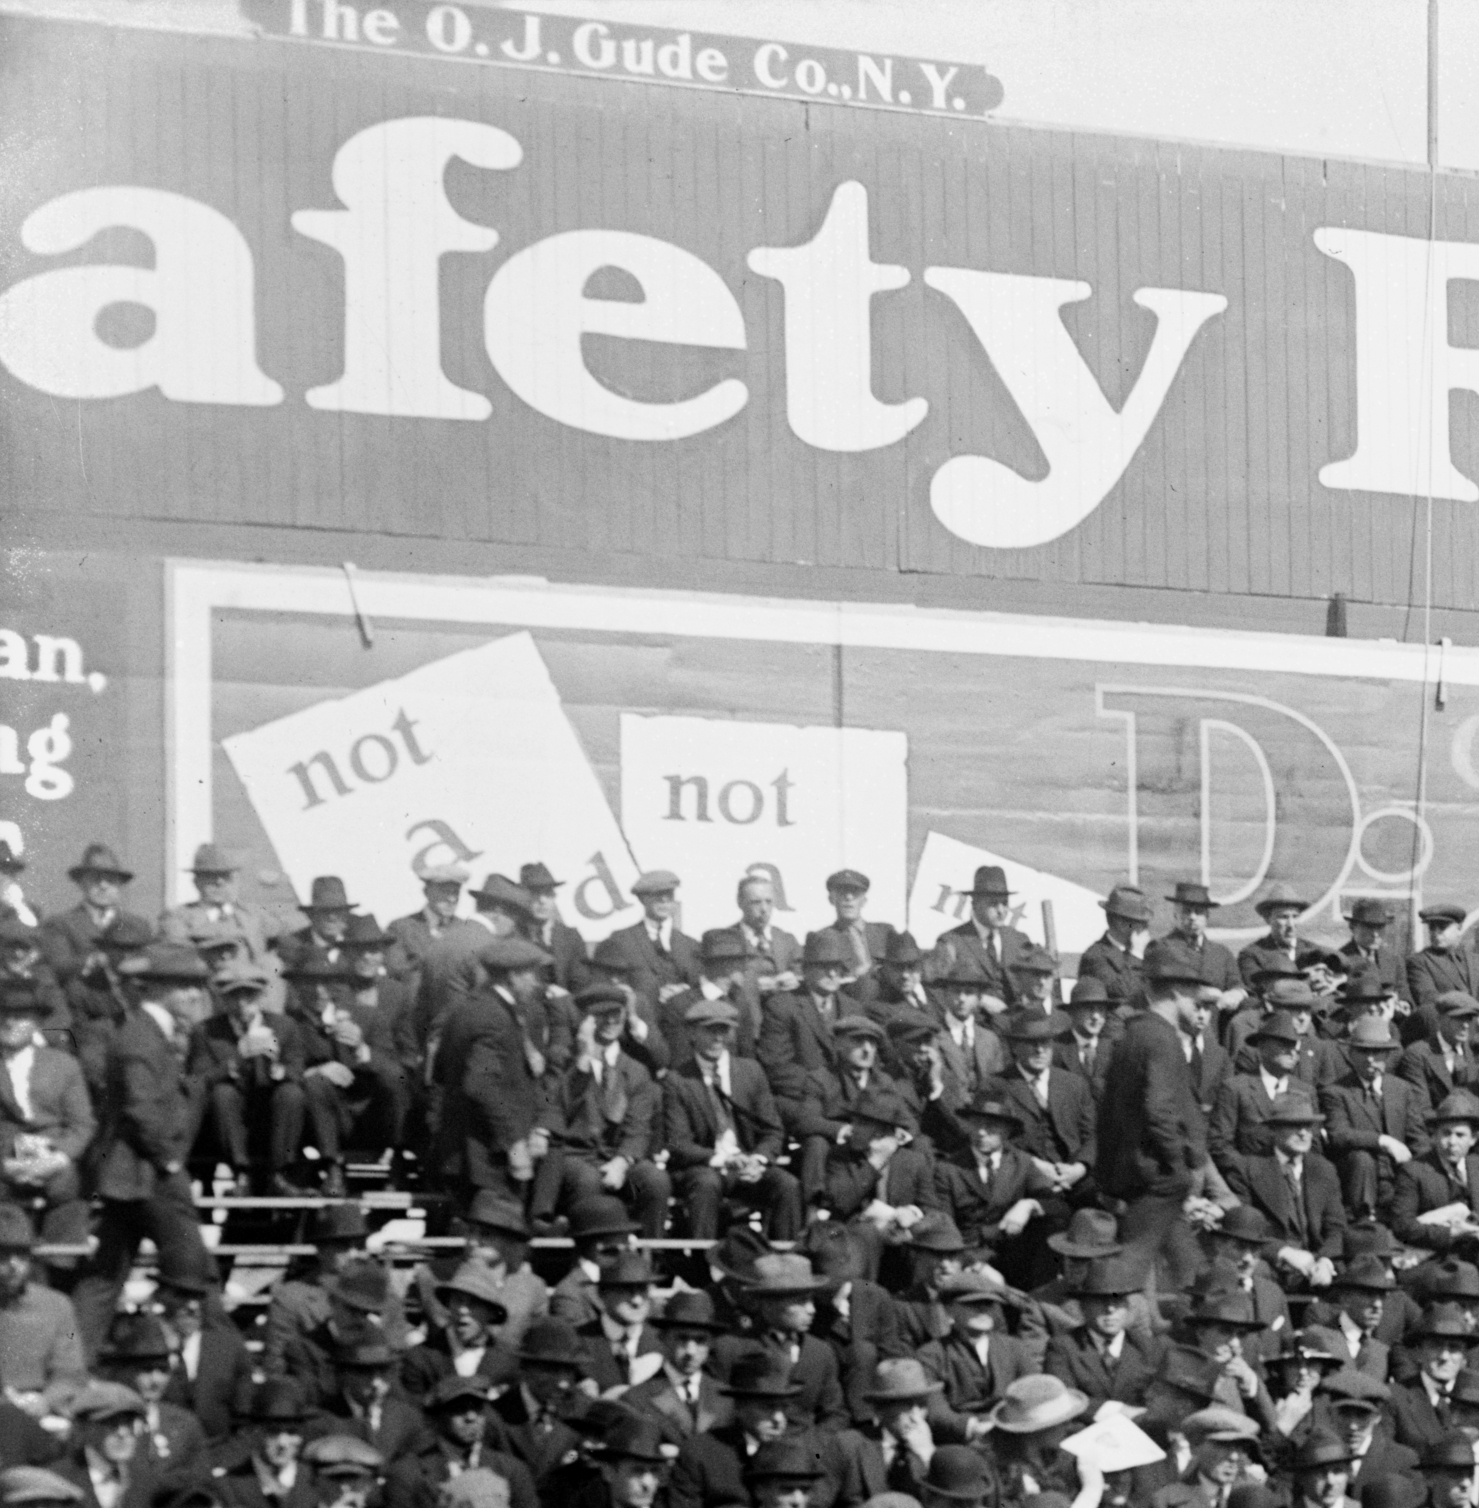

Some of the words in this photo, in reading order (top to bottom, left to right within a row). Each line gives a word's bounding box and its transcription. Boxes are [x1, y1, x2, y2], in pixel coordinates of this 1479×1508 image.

[571, 22, 729, 82] Gude
[285, 705, 434, 812] not
[661, 767, 796, 828] not
[929, 883, 1029, 930] nt
